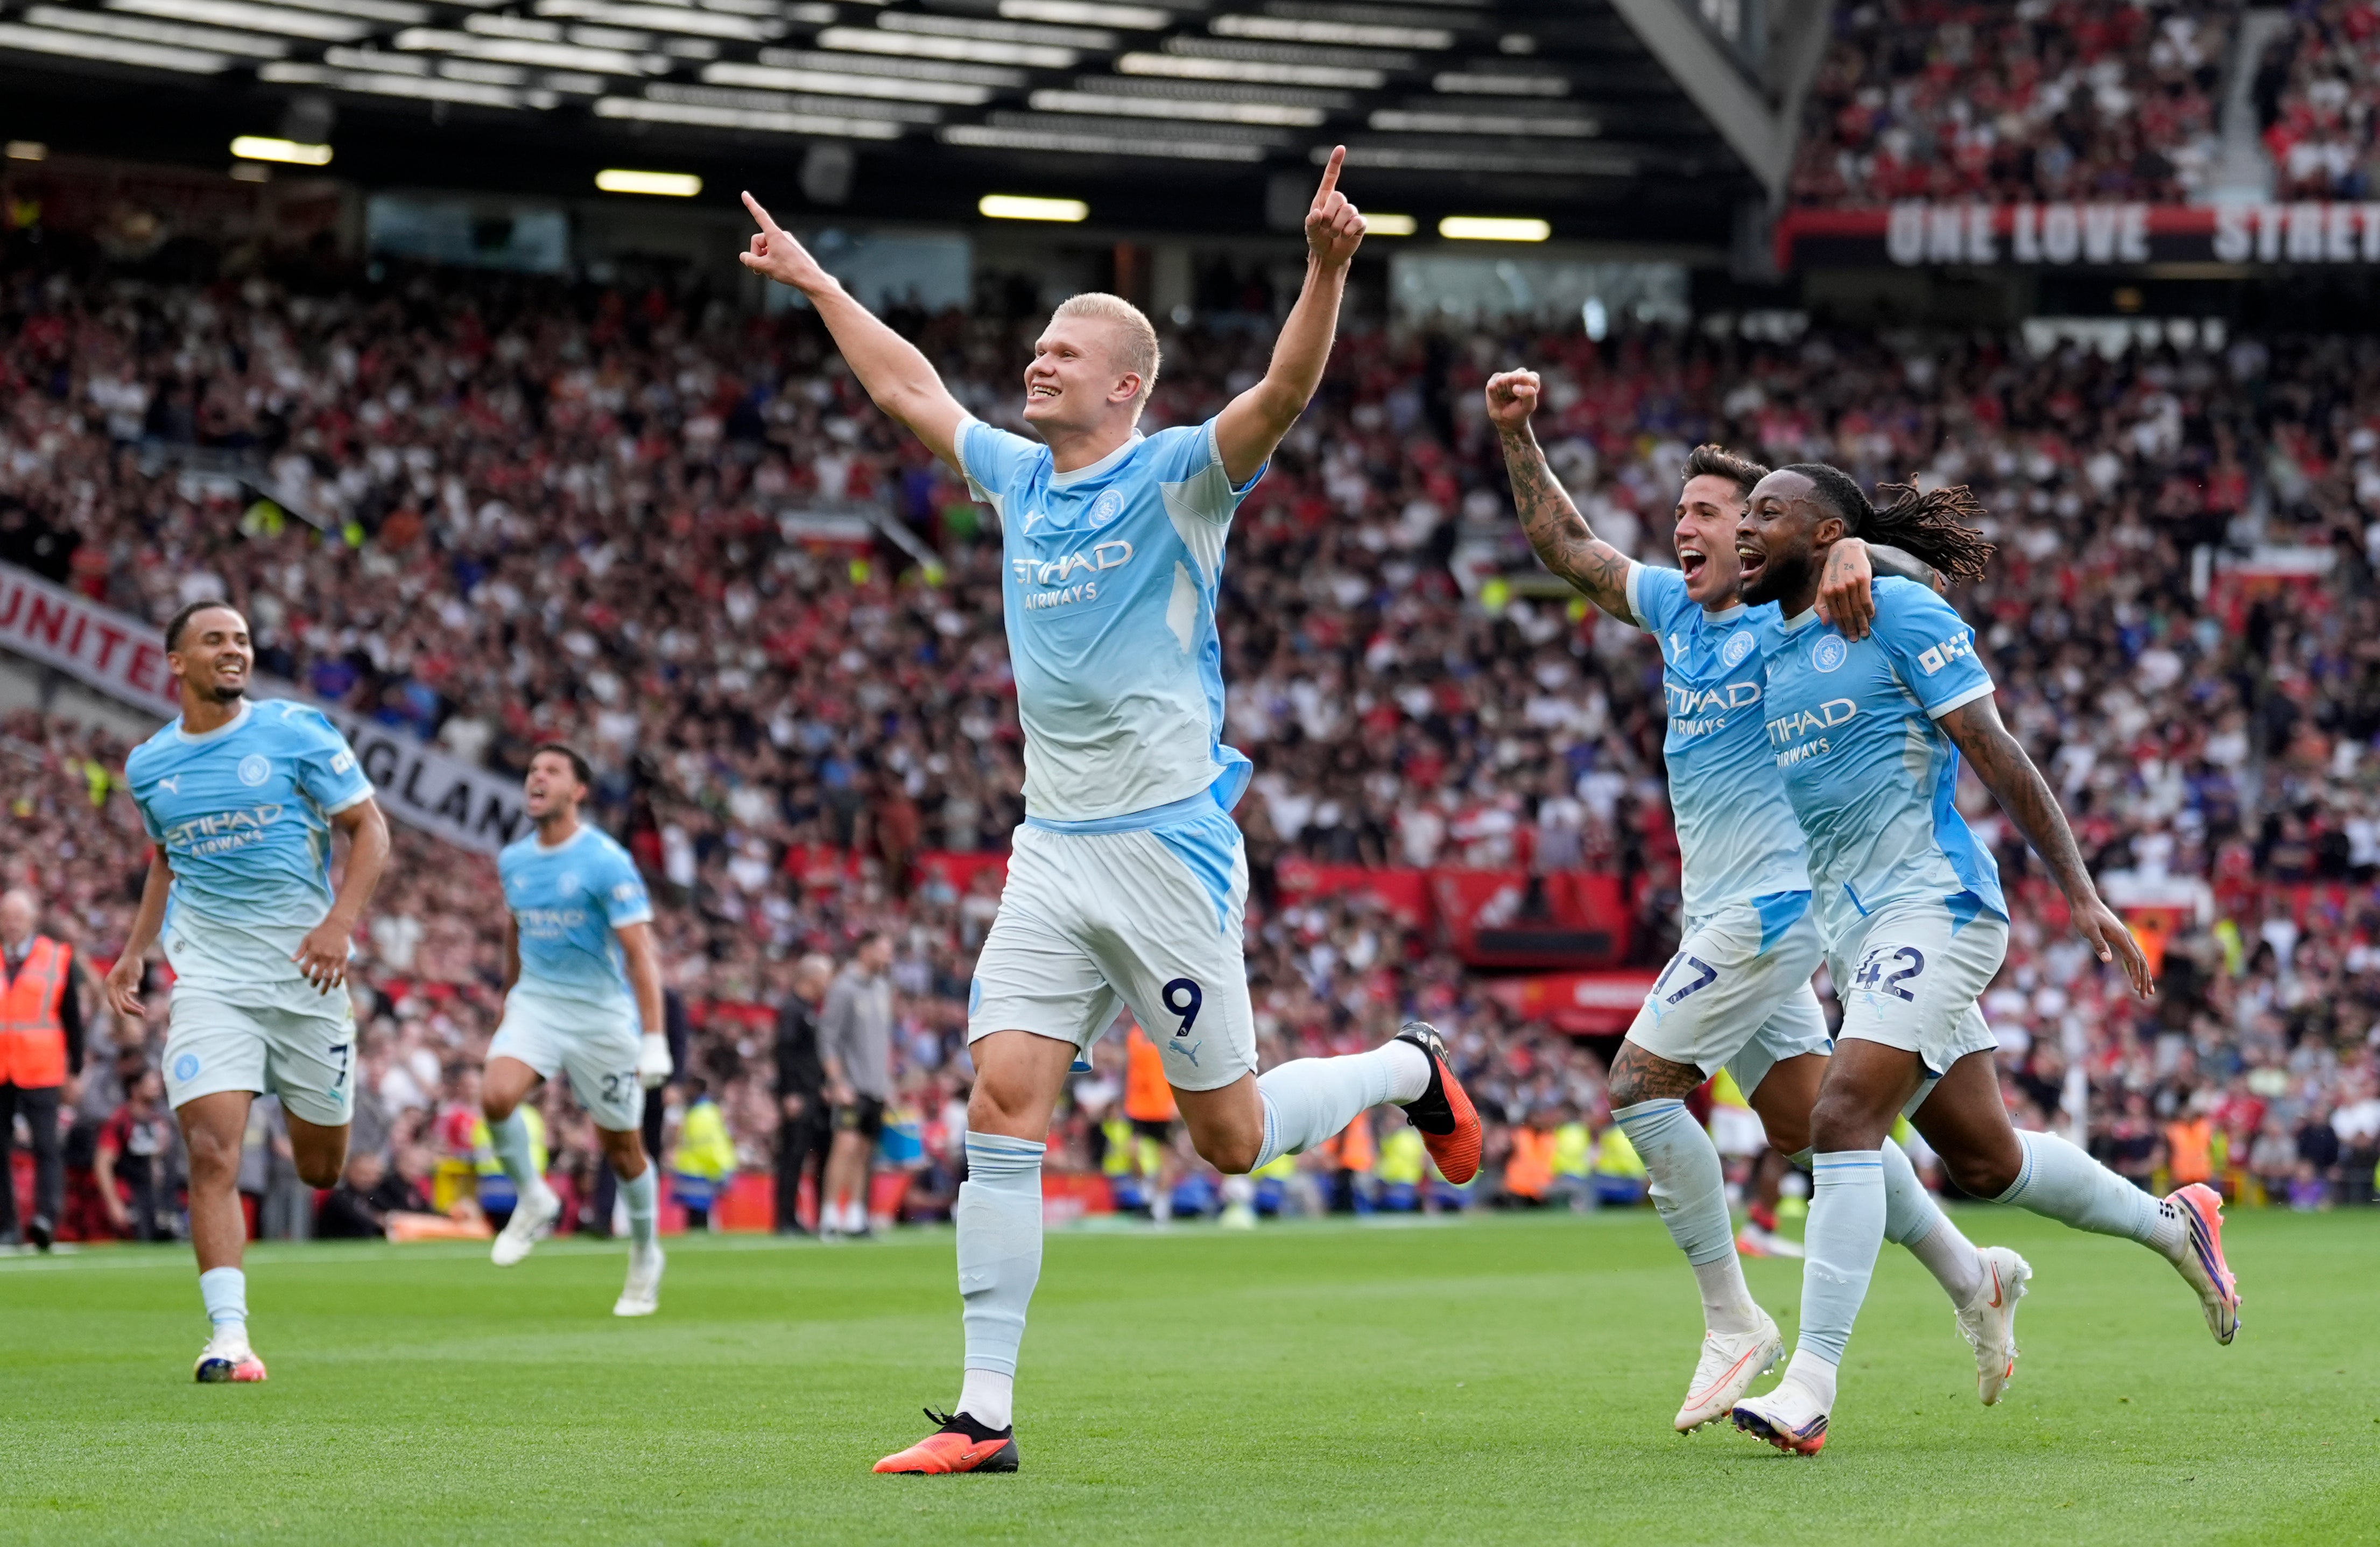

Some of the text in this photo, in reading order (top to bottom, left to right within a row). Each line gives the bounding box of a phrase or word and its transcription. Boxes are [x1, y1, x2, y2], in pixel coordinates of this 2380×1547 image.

[1886, 198, 1998, 266] ONE
[2012, 200, 2150, 266] LOVE
[1012, 540, 1133, 585] ETIHAD
[1025, 582, 1097, 610] AIRWAYS
[1766, 698, 1856, 745] TIHAD
[1776, 738, 1830, 770] AIRWAYS
[165, 805, 283, 846] ETIHAD
[192, 829, 264, 859] AIRWAYS
[1653, 951, 1718, 1004] 17
[1856, 946, 1925, 1002] 42
[1162, 978, 1202, 1037] 9
[329, 1043, 348, 1087] 7
